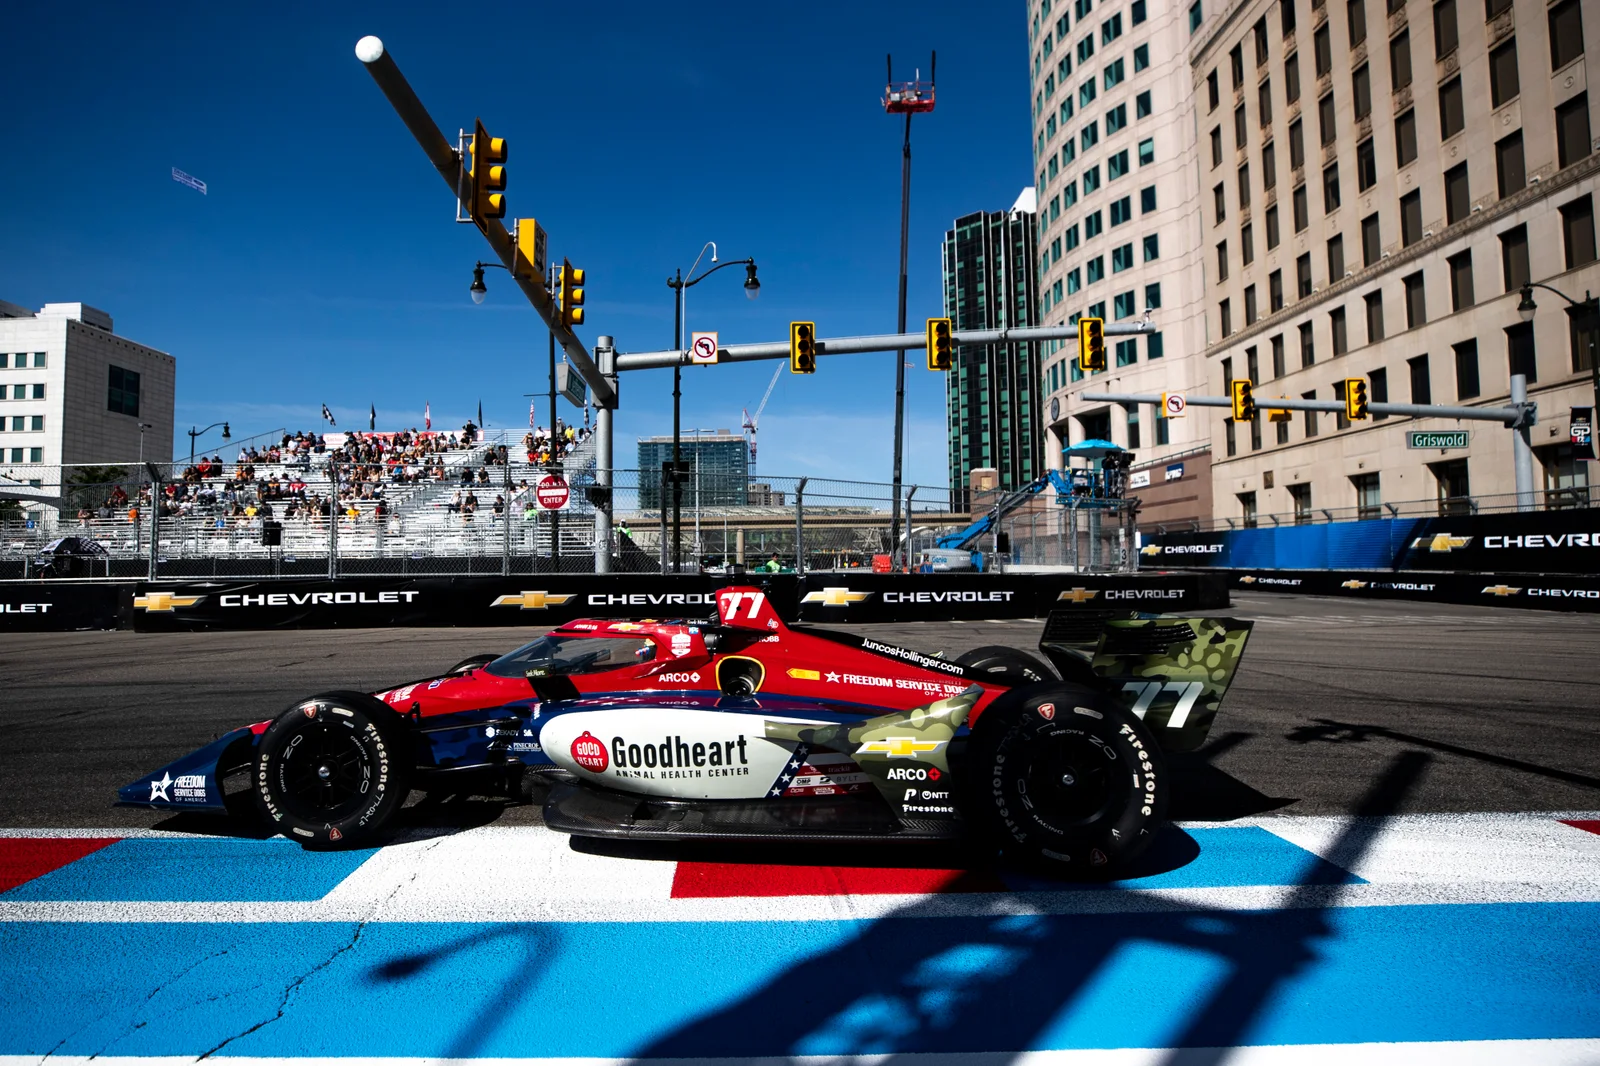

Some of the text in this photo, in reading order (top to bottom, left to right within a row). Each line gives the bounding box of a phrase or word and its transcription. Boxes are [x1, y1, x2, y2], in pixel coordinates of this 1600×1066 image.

[1571, 426, 1590, 437] GP
[1415, 434, 1464, 446] Griswold
[543, 496, 563, 504] ENTER
[1165, 545, 1224, 553] CHEVROLET
[1258, 577, 1302, 585] CHEVROLET
[1371, 582, 1435, 591] CHEVROLET
[220, 591, 419, 607] CHEVROLET
[588, 593, 716, 605] CHEVROL
[883, 591, 1014, 603] CHEVROLET
[1105, 590, 1185, 599] CHEVROLET
[0, 604, 53, 613] LET
[720, 592, 765, 620] 77
[862, 638, 964, 675] JuncosHollinger.com
[659, 673, 690, 682] ARCO
[843, 674, 893, 687] FREEDOM
[896, 679, 942, 692] SERVICE
[1121, 682, 1204, 728] 77
[577, 742, 600, 756] GOOD
[612, 734, 748, 768] Goodheart
[364, 722, 389, 792] Firestone
[577, 757, 604, 767] HEART
[616, 768, 750, 780] ANIMAL HEALTH CENTER
[887, 768, 927, 780] ARCO
[1118, 723, 1156, 817] Firestone
[174, 775, 206, 788] FREEDOM
[260, 753, 283, 822] Firestone
[174, 788, 206, 797] SERVICE DOGS
[993, 754, 1027, 843] Firestone
[902, 804, 954, 813] Firestone
